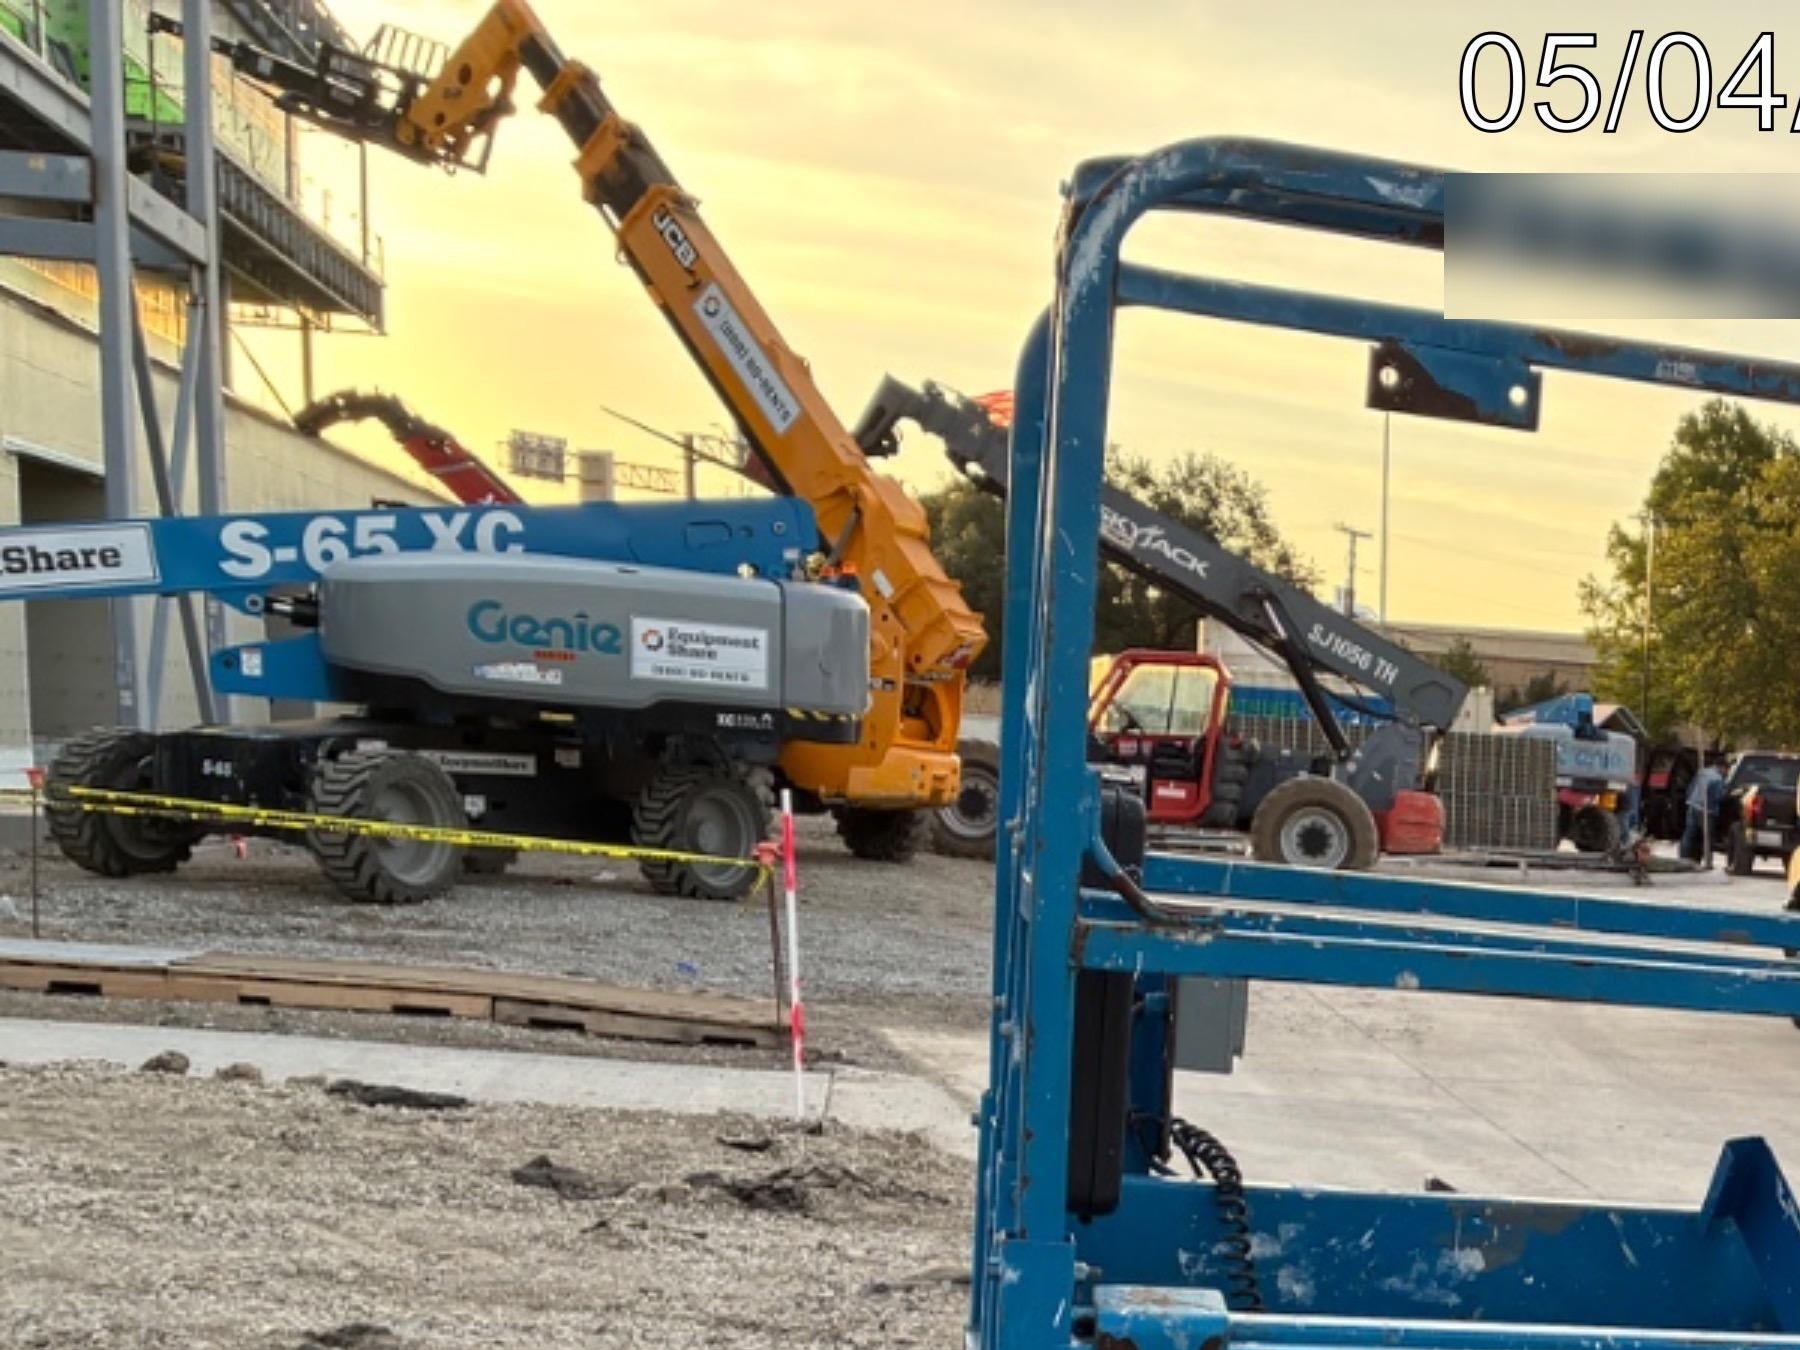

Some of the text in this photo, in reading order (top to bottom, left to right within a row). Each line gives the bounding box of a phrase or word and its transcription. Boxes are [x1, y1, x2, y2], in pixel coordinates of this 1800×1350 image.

[652, 206, 699, 270] JCB
[0, 543, 121, 574] Share
[218, 511, 524, 579] S-65 XC
[467, 600, 621, 655] Genie
[668, 627, 759, 649] Equipment
[668, 643, 717, 660] Share
[1307, 623, 1399, 685] SJ1056 TH
